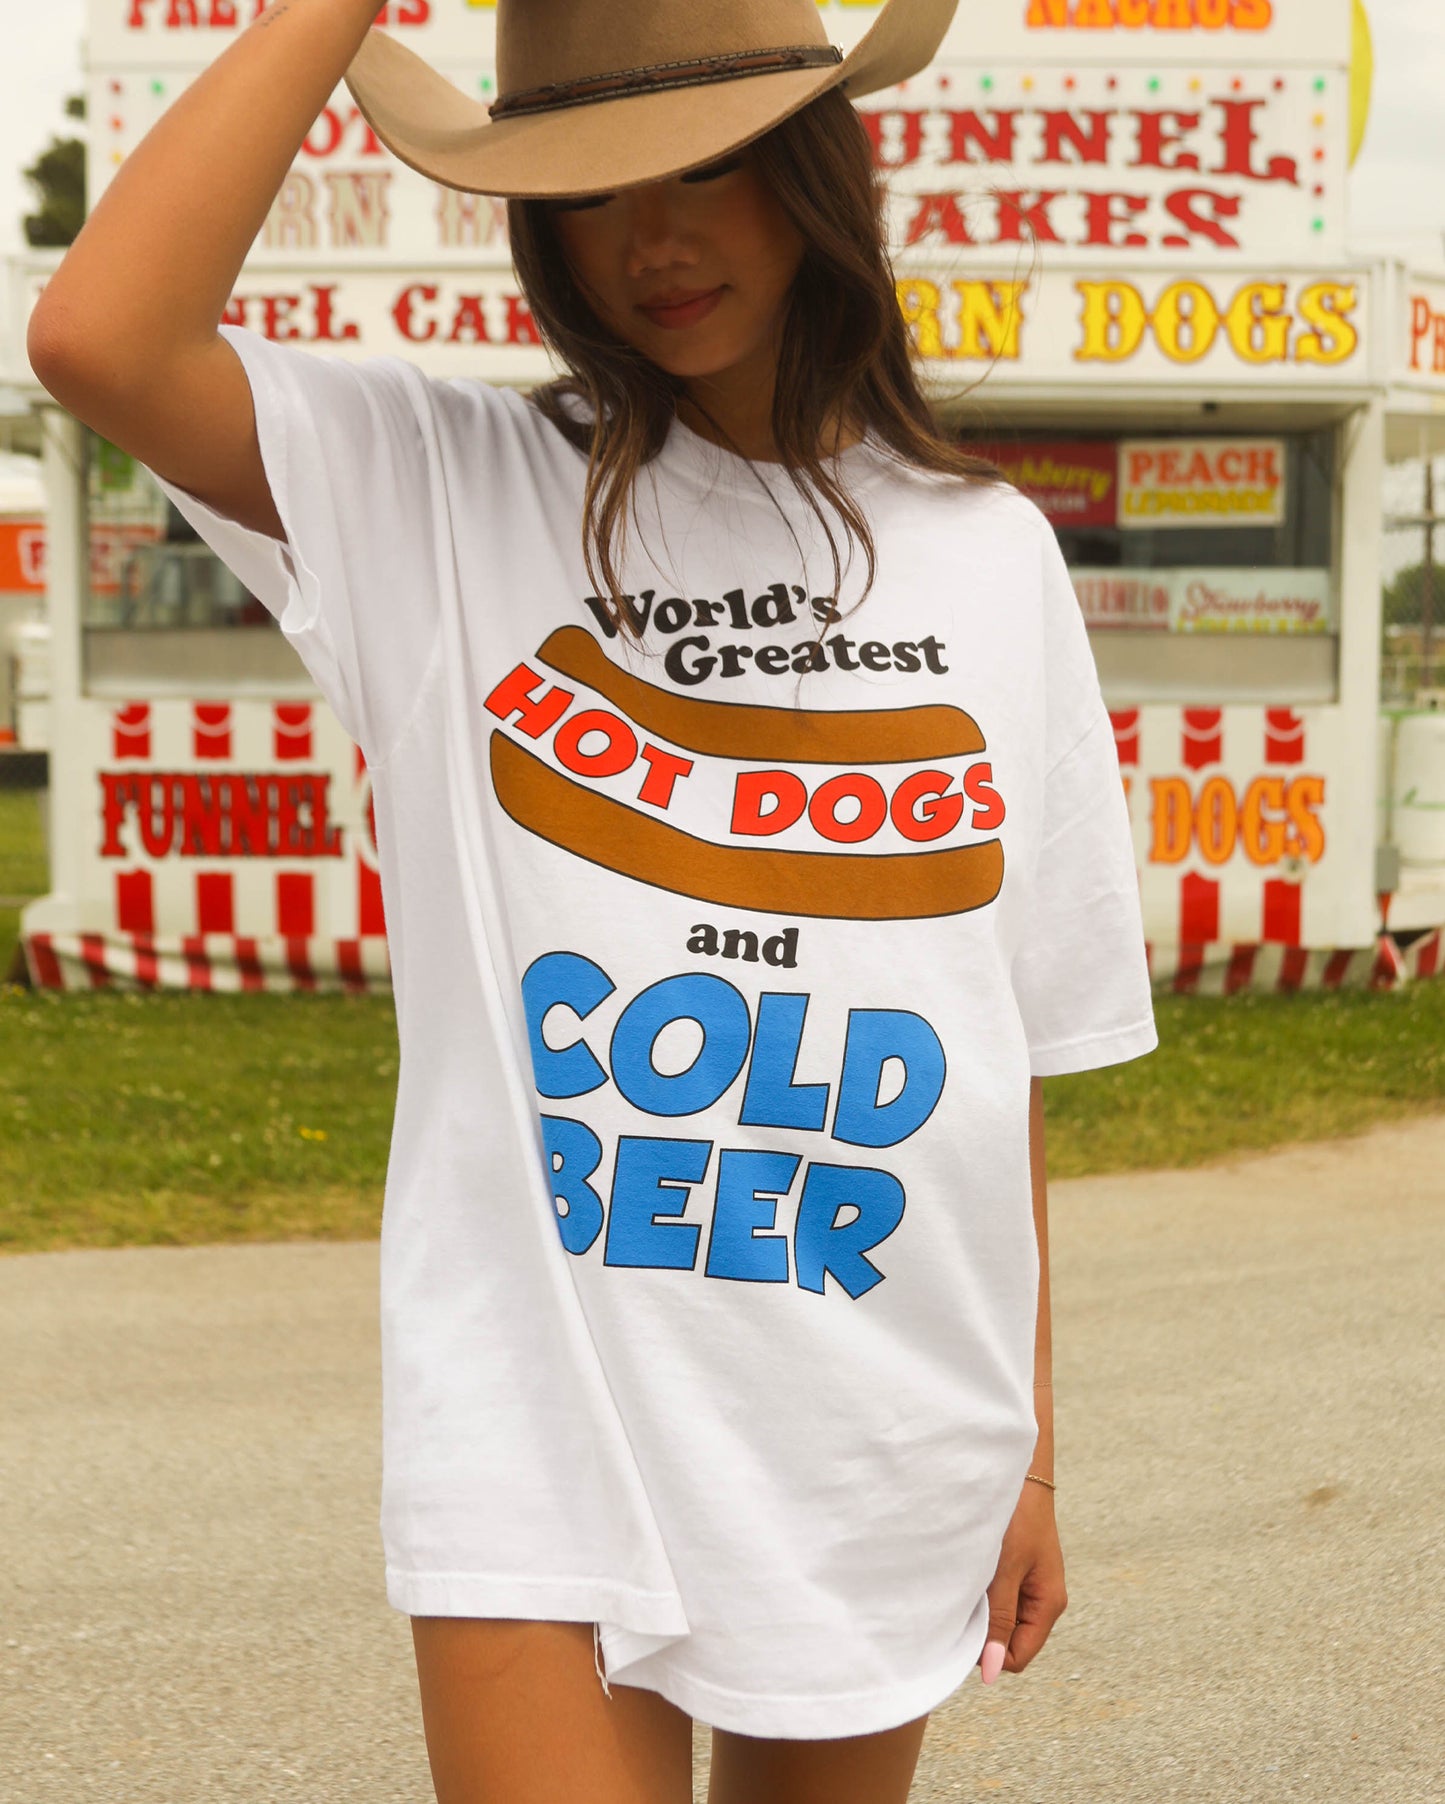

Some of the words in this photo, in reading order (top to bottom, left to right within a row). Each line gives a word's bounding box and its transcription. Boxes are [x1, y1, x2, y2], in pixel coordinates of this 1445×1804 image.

[881, 187, 1242, 249] AKES
[1074, 279, 1359, 365] DOGS
[1128, 447, 1281, 487] PEACH
[584, 583, 842, 639] World's
[664, 634, 949, 686] Greatest
[483, 662, 694, 809] HOT
[730, 761, 1006, 844] DOGS
[98, 770, 345, 859] FUNNEL
[1147, 774, 1325, 867] DOGS
[686, 923, 801, 969] and
[521, 950, 947, 1149] COLD
[539, 1113, 906, 1300] BEER
